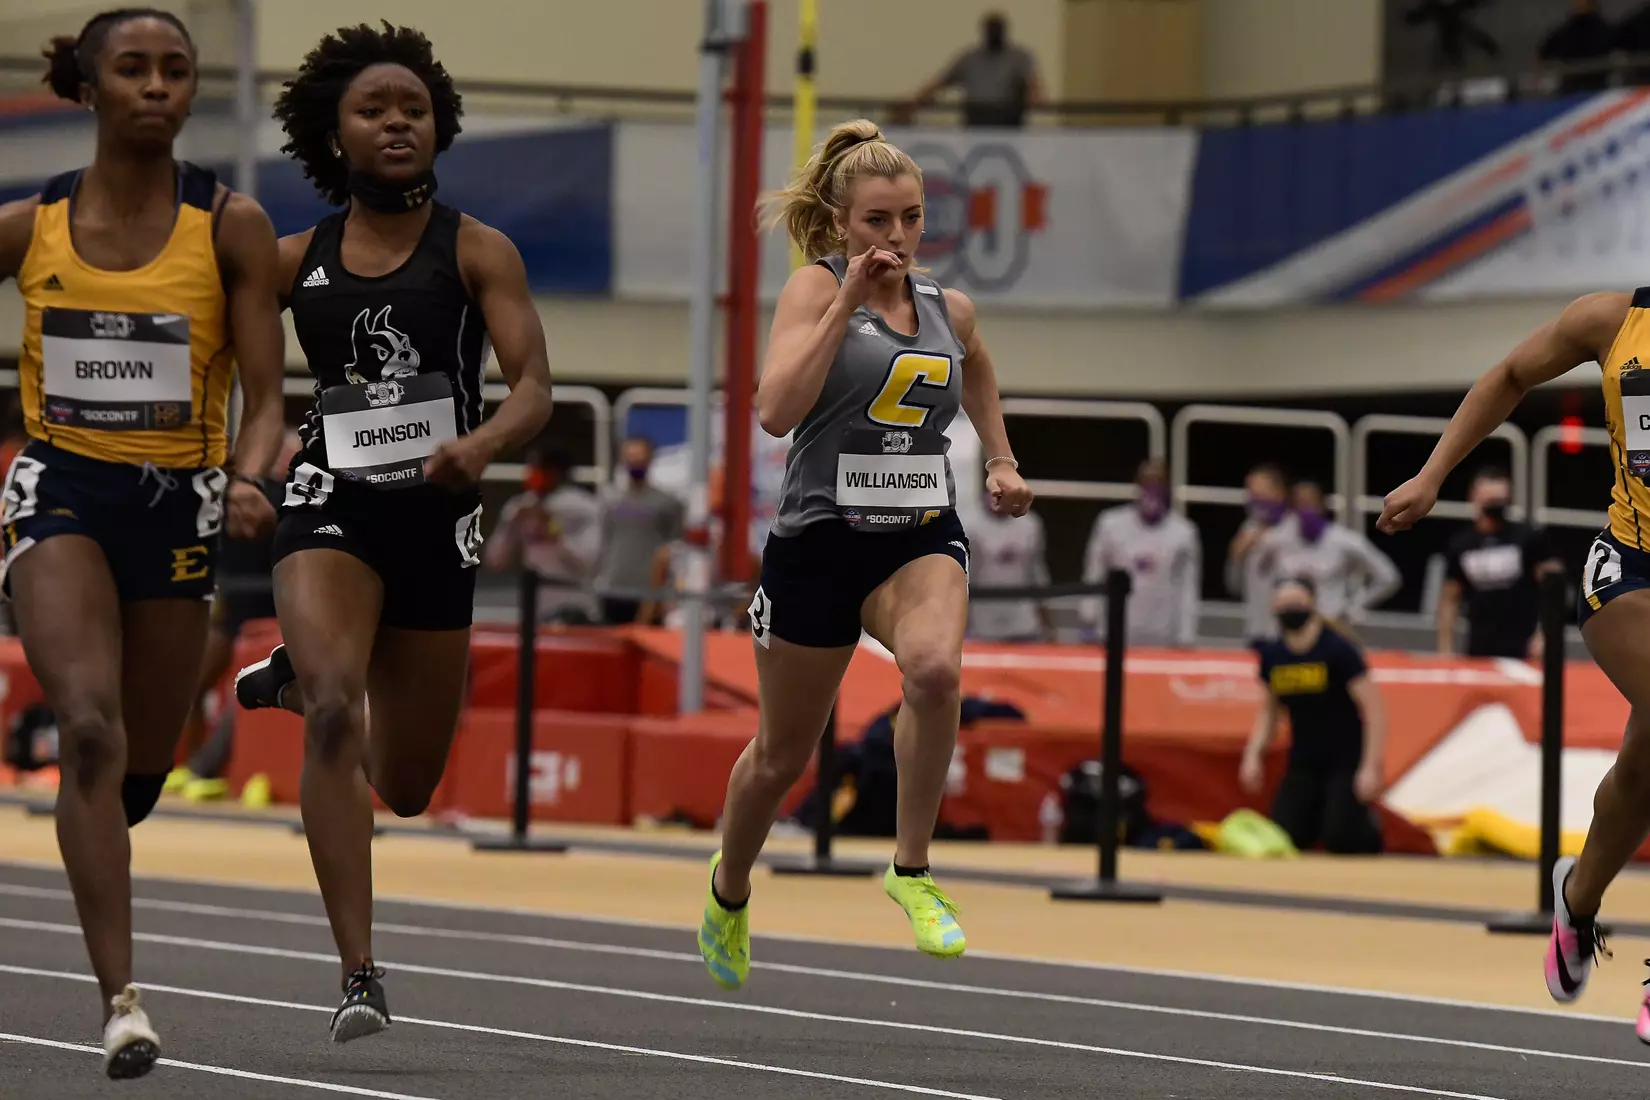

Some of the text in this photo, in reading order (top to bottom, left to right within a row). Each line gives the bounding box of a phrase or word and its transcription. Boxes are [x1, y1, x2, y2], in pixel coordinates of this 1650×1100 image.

[302, 278, 330, 288] adidas
[75, 360, 153, 379] BROWN
[863, 349, 953, 428] C
[352, 420, 431, 449] JOHNSON
[366, 468, 417, 484] #SOCONTF
[846, 472, 938, 489] WILLIAMSON
[866, 514, 912, 524] #SOCONTF
[171, 545, 209, 581] E
[1592, 543, 1612, 592] 2
[752, 588, 765, 639] 3
